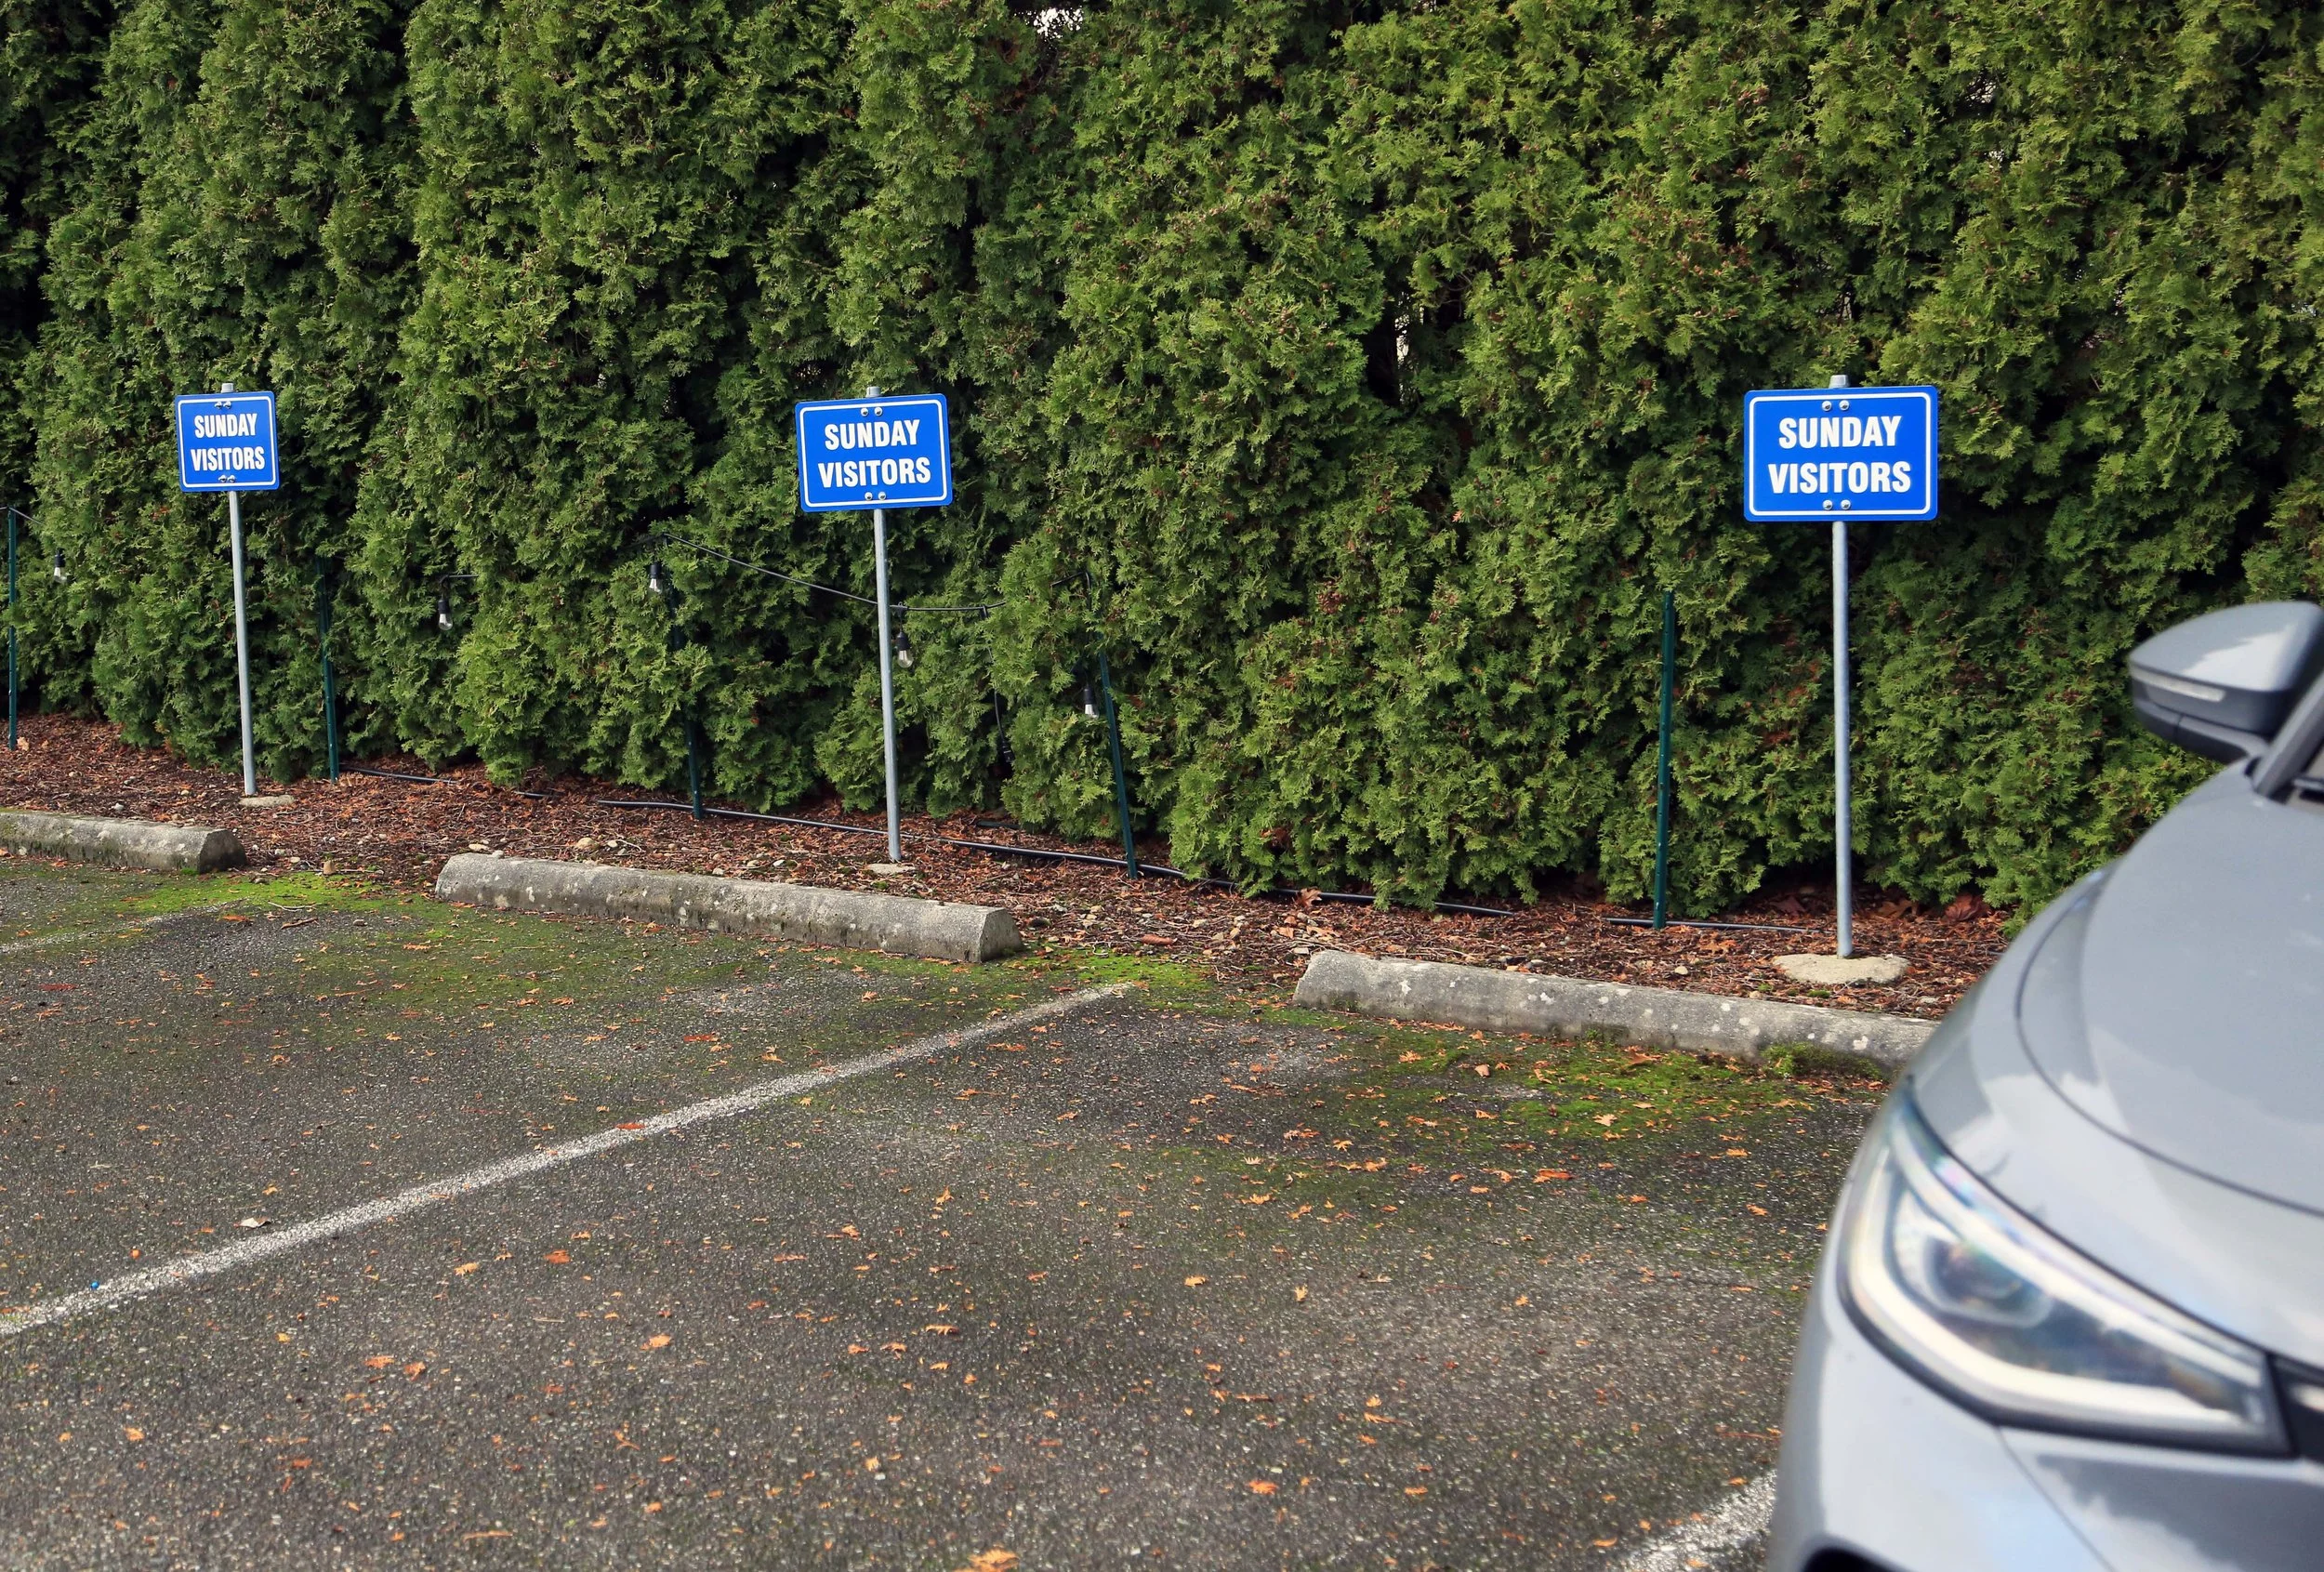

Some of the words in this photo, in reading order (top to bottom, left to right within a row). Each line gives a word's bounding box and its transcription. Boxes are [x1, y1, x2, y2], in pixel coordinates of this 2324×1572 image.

[194, 414, 257, 438] SUNDAY
[825, 419, 919, 450] SUNDAY
[1778, 416, 1902, 449] SUNDAY
[191, 446, 265, 471] VISITORS
[817, 456, 931, 488] VISITORS
[1767, 461, 1911, 494] VISITORS
